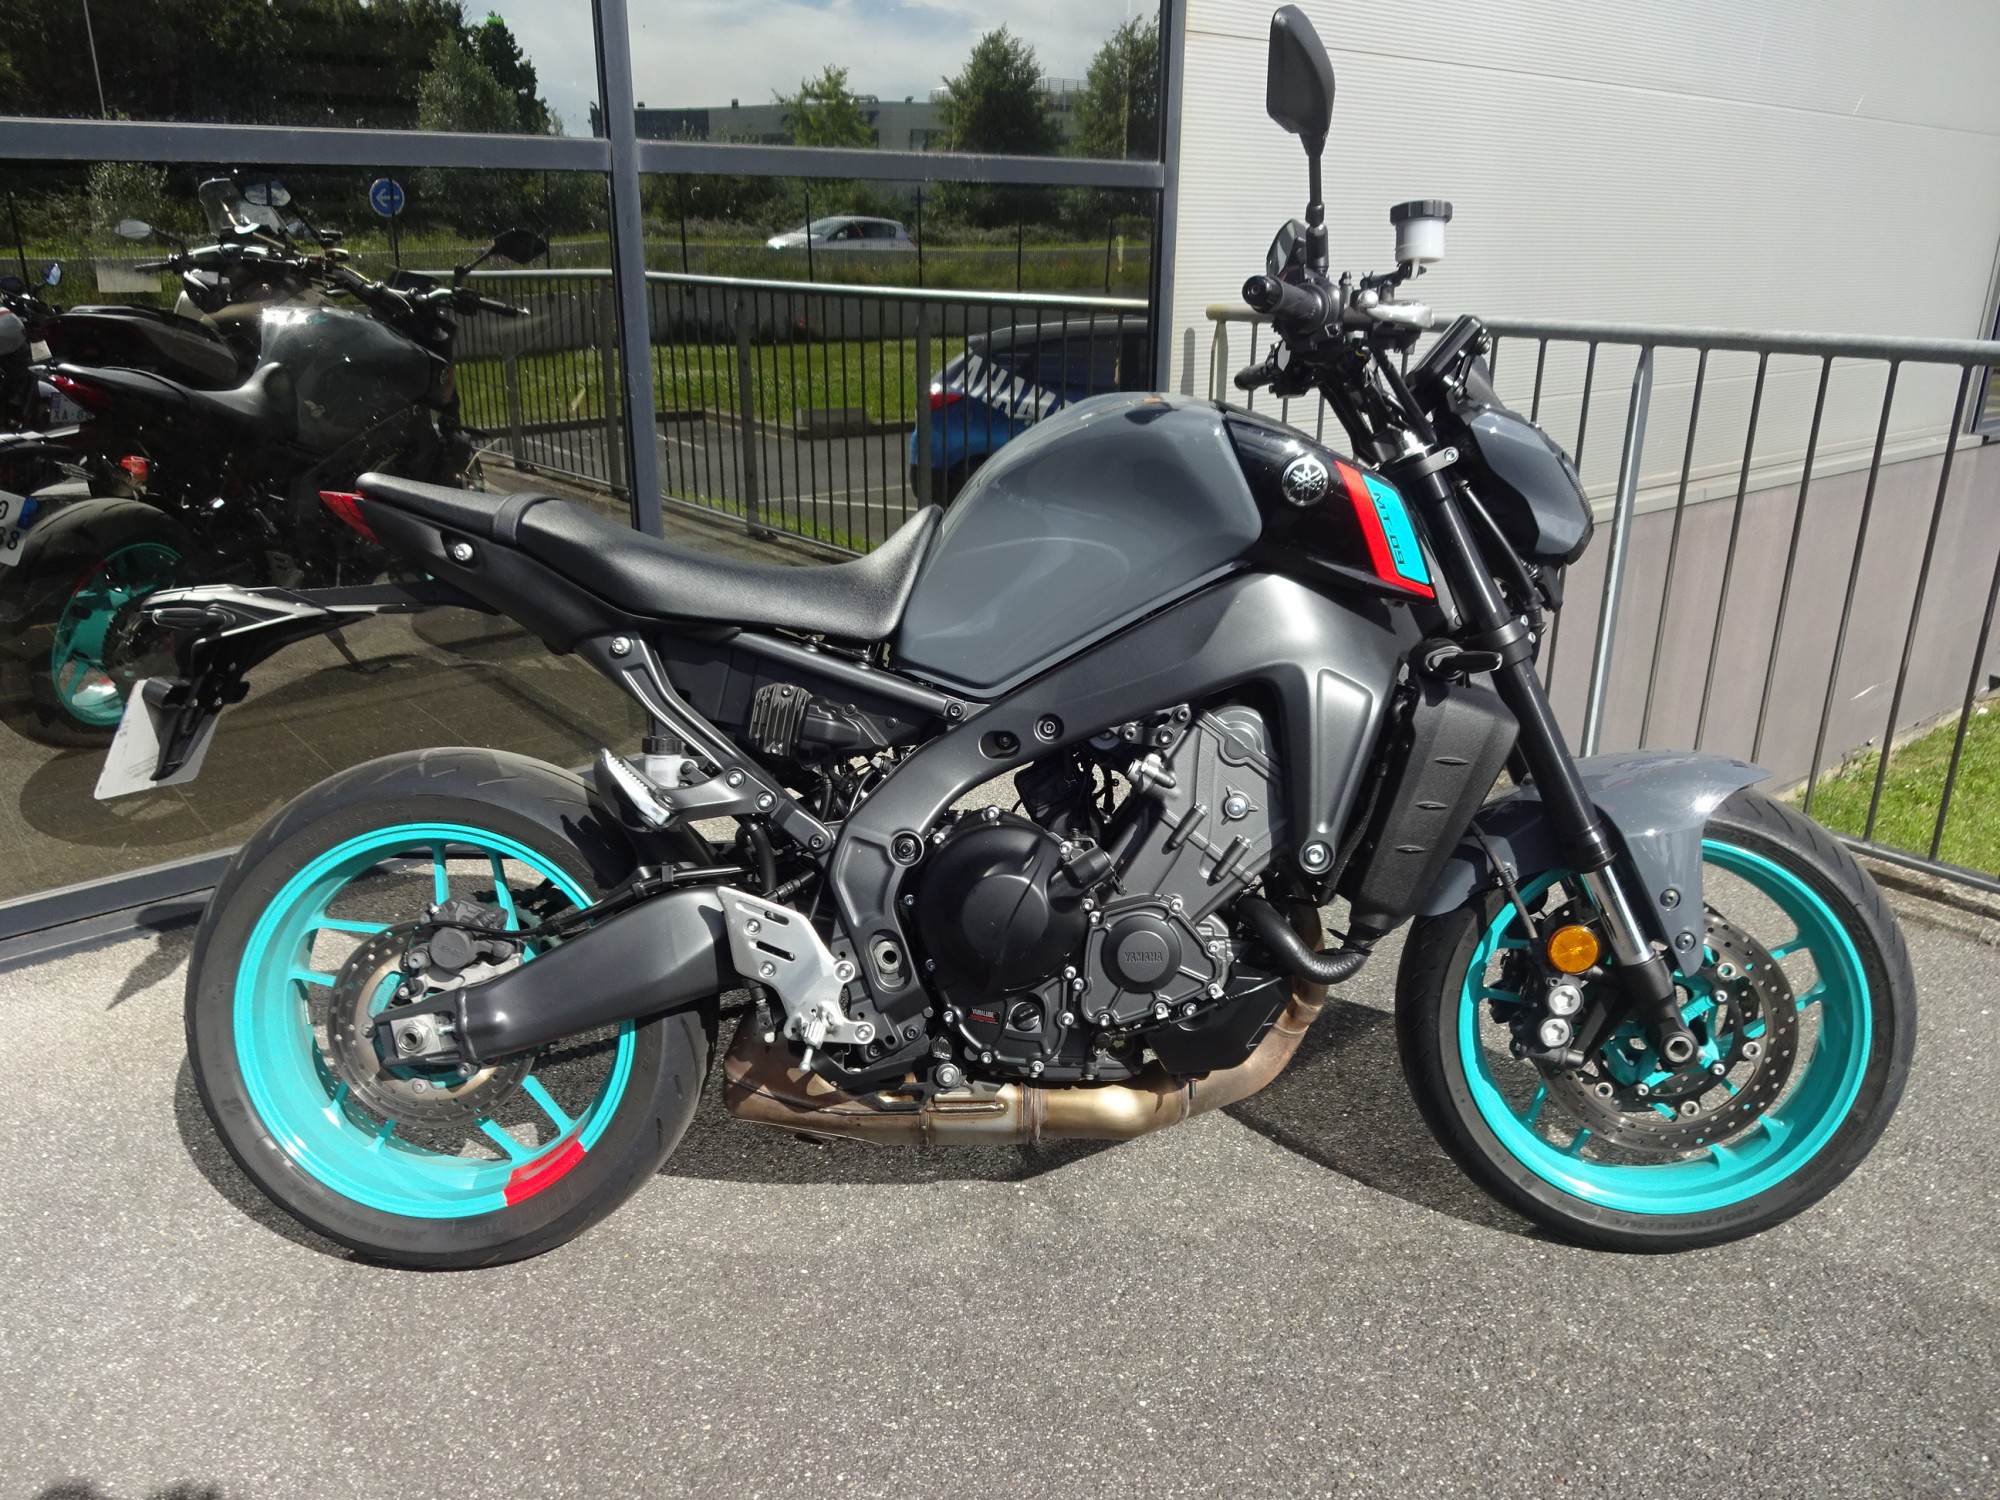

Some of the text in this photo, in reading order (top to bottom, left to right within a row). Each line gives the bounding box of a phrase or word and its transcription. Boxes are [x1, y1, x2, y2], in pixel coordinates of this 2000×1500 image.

[1372, 492, 1406, 566] MT-09
[1124, 951, 1163, 963] YAMAHA
[971, 1007, 994, 1019] YAMALUBE
